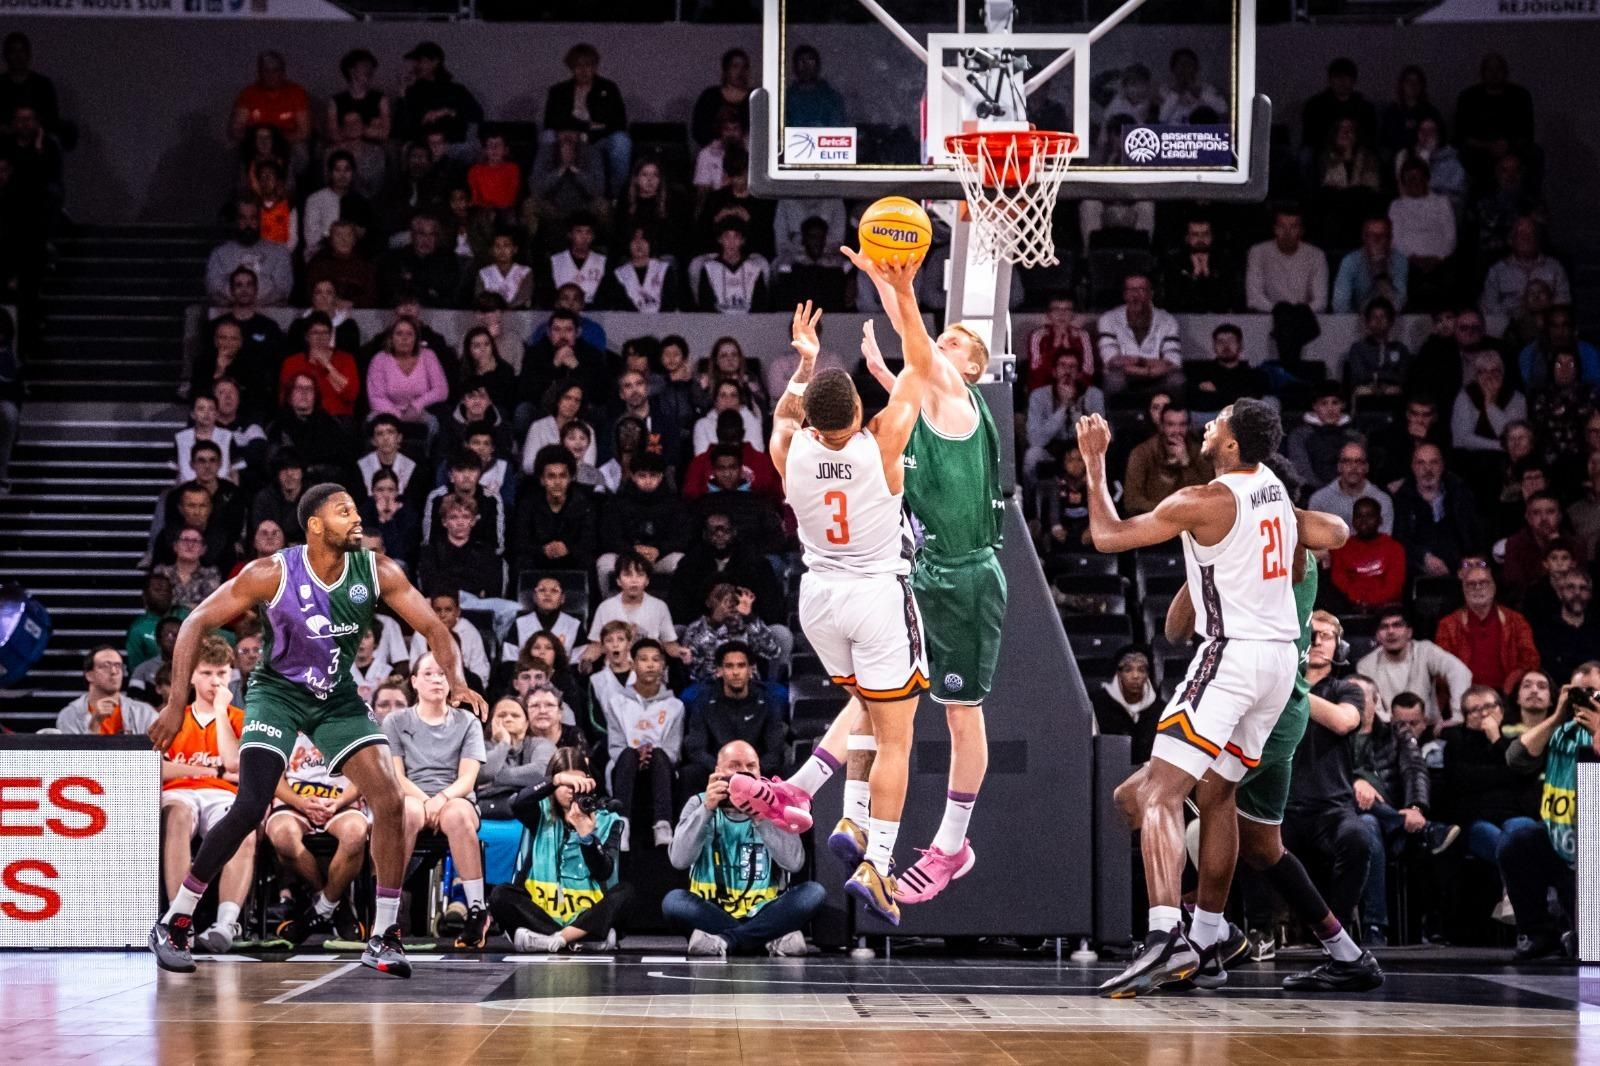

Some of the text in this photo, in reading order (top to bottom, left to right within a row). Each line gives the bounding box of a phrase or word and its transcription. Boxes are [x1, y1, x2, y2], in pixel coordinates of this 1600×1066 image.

[1160, 132, 1222, 141] BASKETBALL
[1160, 141, 1230, 151] CHAMPIONS
[1160, 150, 1198, 159] LEAGUE
[872, 225, 918, 244] Wilson
[815, 462, 852, 480] JONES
[824, 491, 850, 545] 3
[1260, 517, 1288, 581] 21
[327, 647, 341, 675] 3
[0, 859, 63, 922] S
